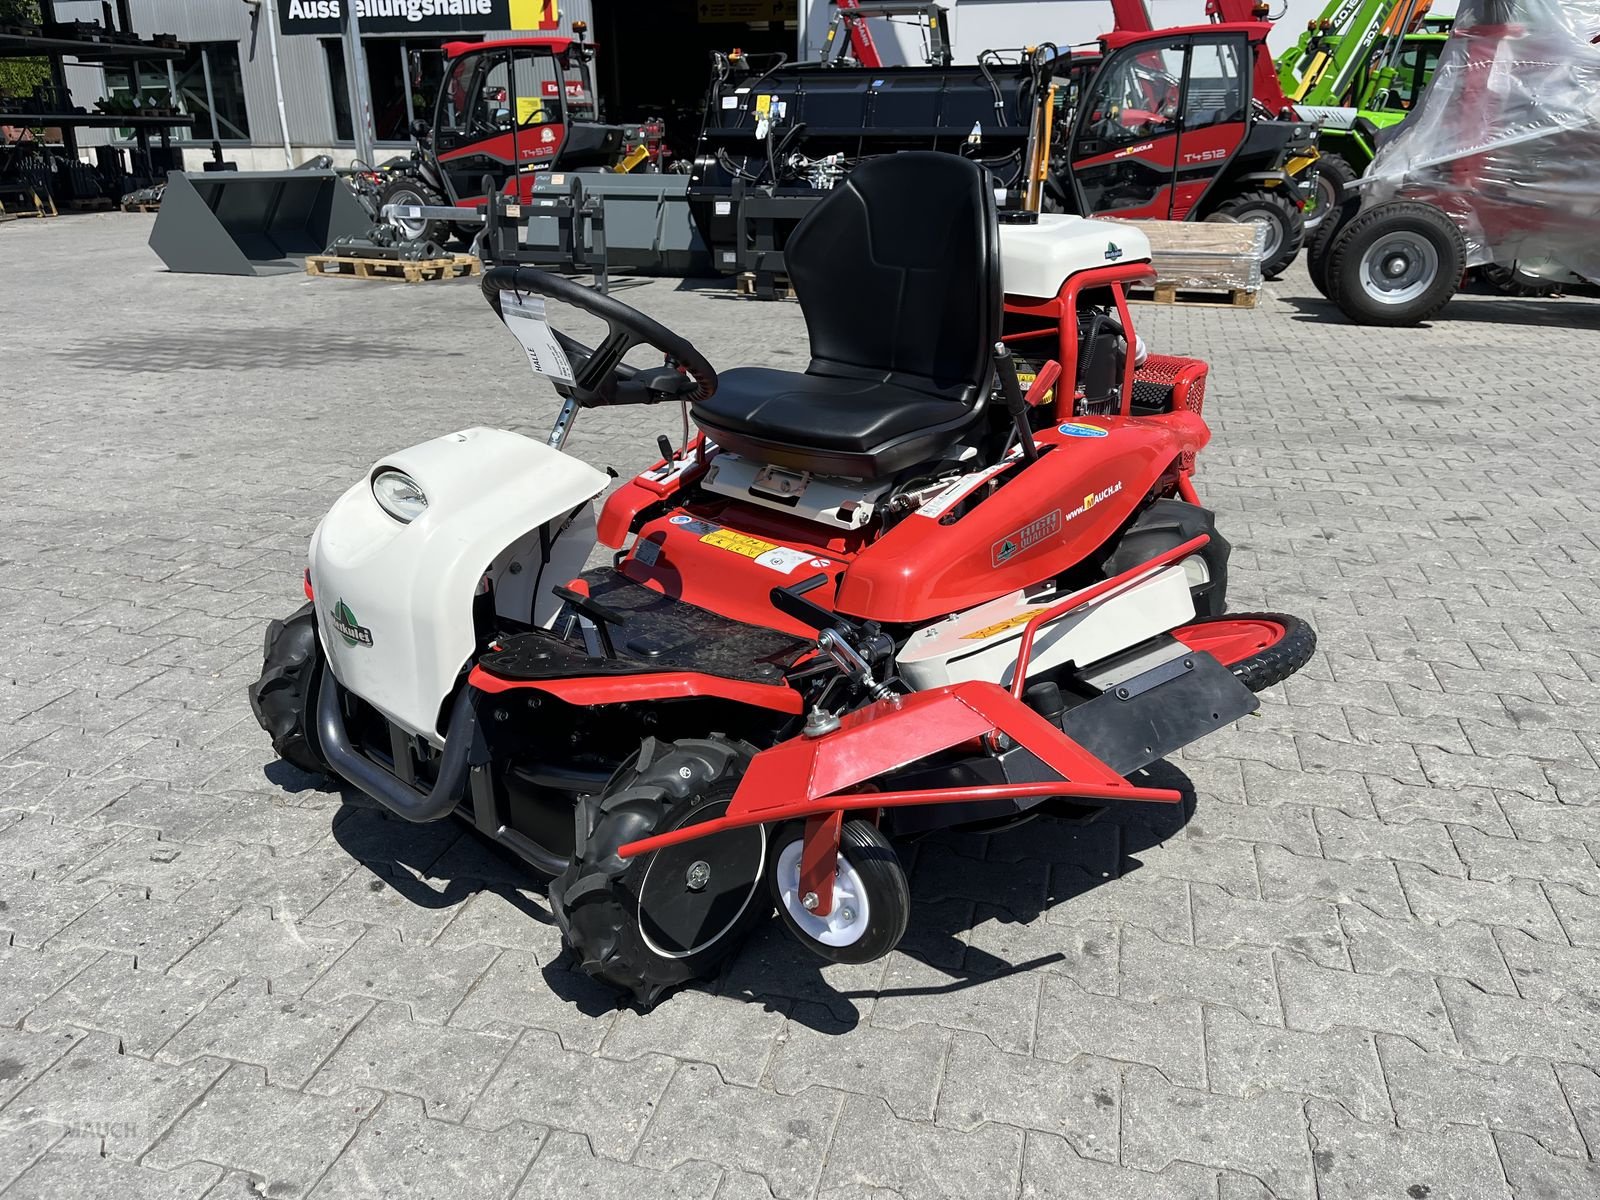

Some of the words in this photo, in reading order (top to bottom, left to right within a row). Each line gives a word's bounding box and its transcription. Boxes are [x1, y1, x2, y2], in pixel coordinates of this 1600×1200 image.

[288, 0, 492, 21] Aussellungshalle
[1363, 21, 1381, 47] 30.7
[1184, 149, 1226, 163] T4512
[527, 346, 543, 373] HALLE
[1065, 480, 1123, 522] www.MAUCH.at
[1020, 511, 1057, 540] HIGH
[1020, 521, 1058, 549] QUALITY
